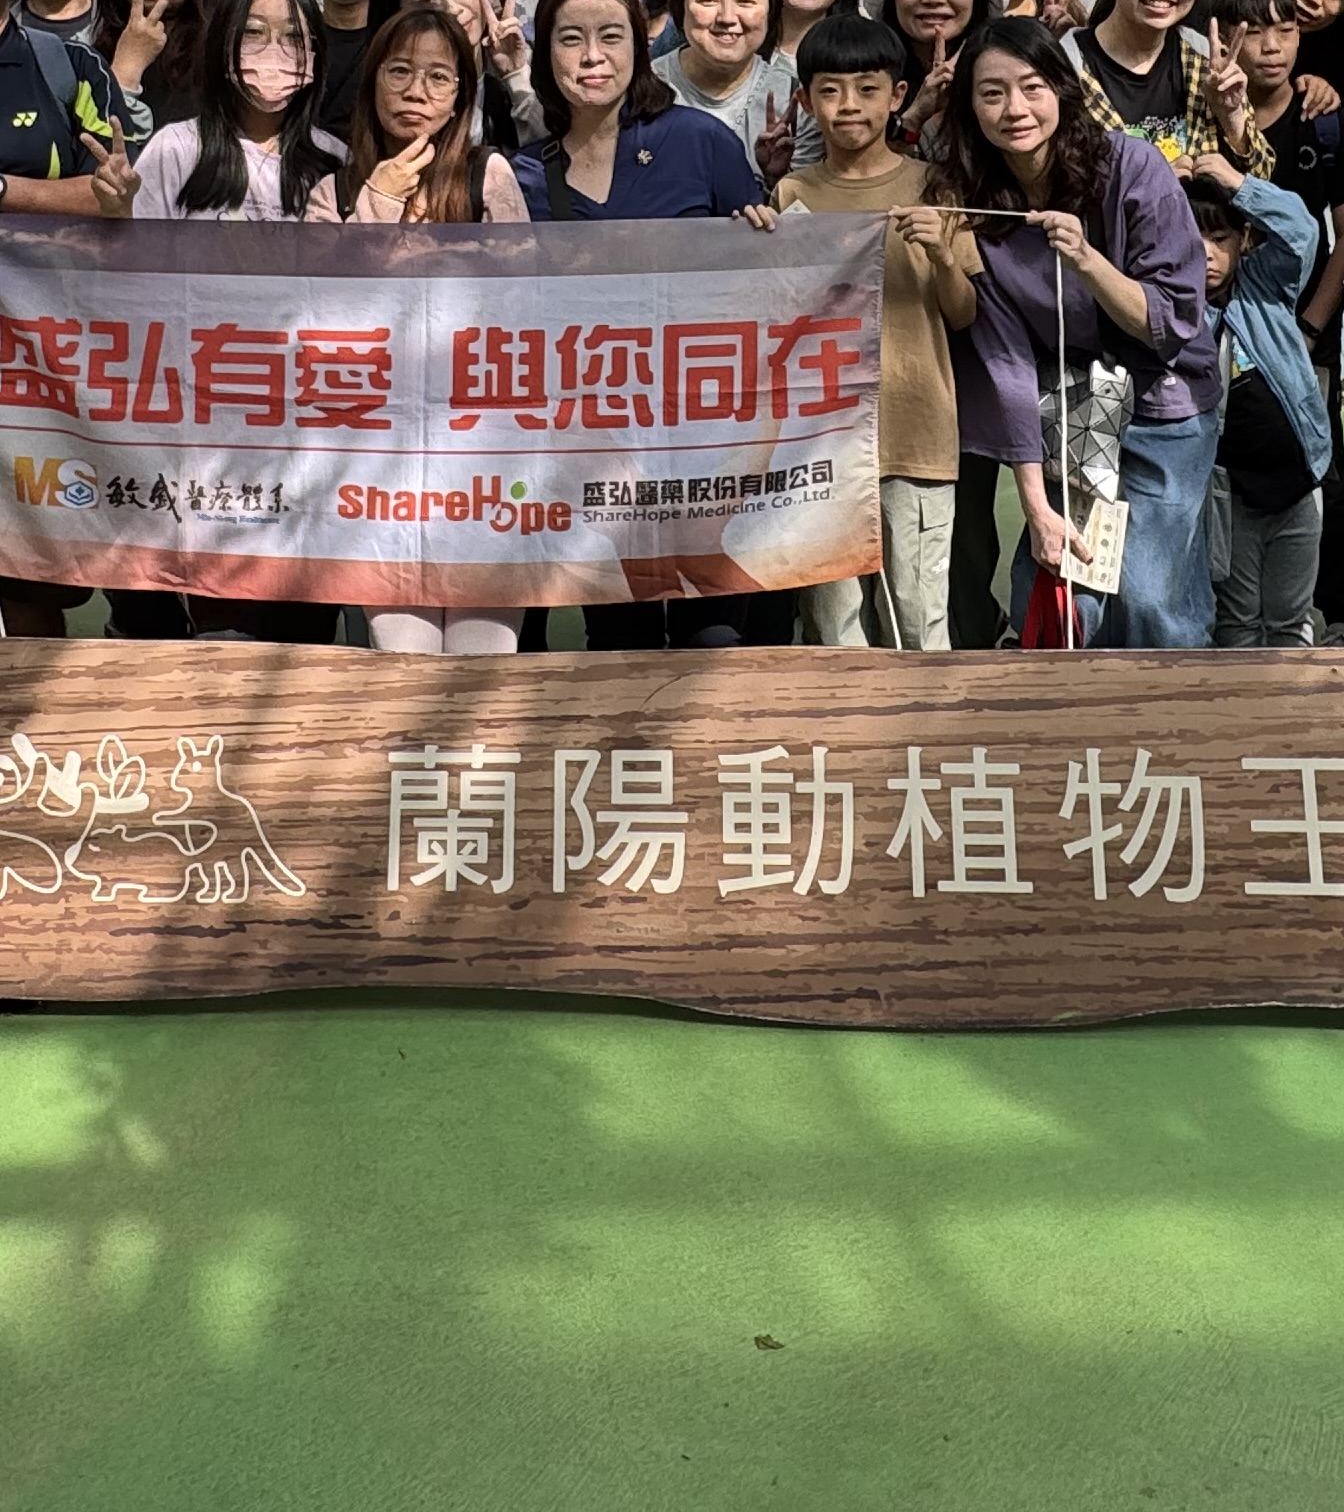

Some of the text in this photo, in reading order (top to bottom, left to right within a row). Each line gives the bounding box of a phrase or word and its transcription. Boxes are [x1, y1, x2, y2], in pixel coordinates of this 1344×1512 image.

[449, 315, 862, 430] 與您同在
[338, 475, 572, 535] ShareHope
[582, 459, 834, 507] 盛弘醫藥股份有限公司
[582, 508, 681, 524] ShareHope
[686, 499, 766, 519] Medicine
